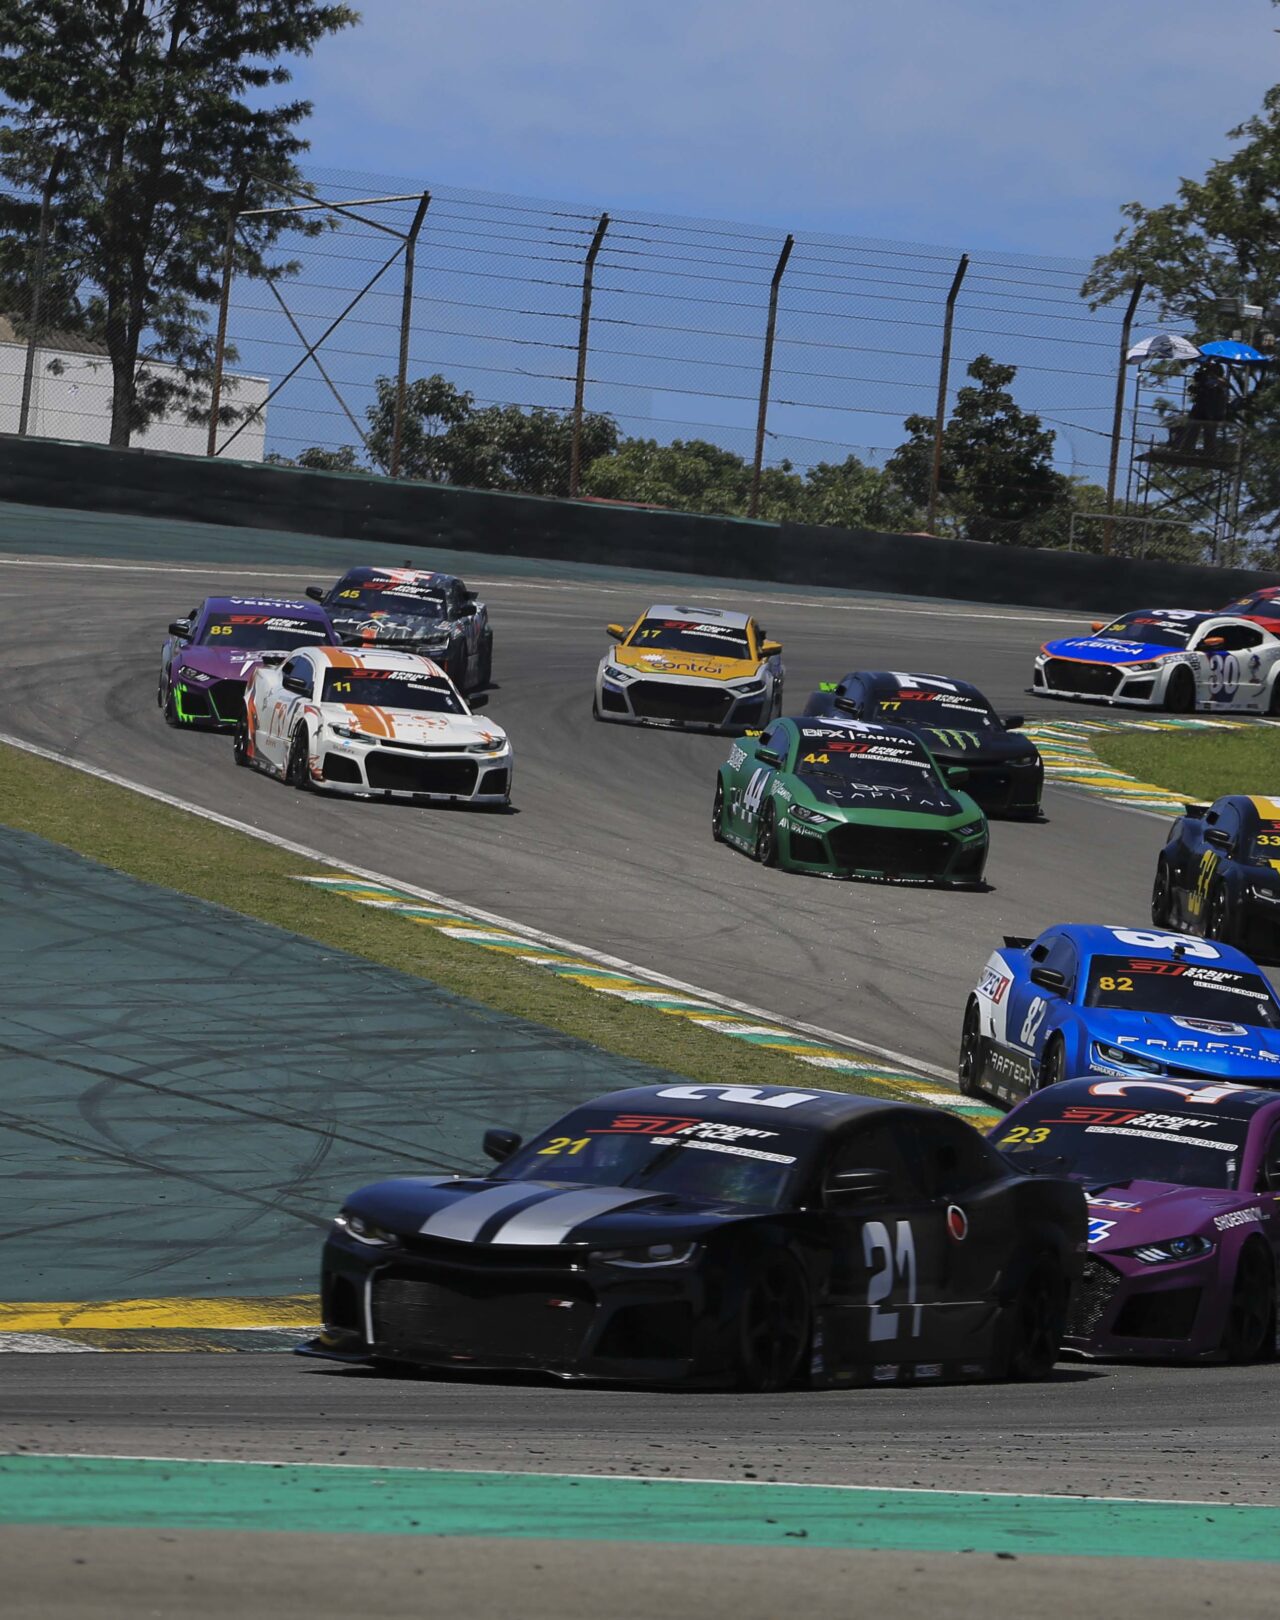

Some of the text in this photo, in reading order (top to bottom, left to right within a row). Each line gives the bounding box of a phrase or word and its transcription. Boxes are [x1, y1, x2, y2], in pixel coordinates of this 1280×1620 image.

[340, 589, 361, 599] 45
[210, 625, 233, 636] 85
[641, 629, 662, 639] 17
[1109, 624, 1127, 632] 30
[650, 660, 722, 674] control
[1208, 653, 1240, 695] 30
[333, 681, 352, 692] 11
[879, 701, 902, 711] 77
[856, 733, 916, 746] CAPITAL
[803, 753, 830, 764] 44
[743, 767, 771, 814] 44
[826, 789, 952, 808] CAPITAL
[1181, 970, 1224, 984] RACE
[1187, 966, 1243, 982] SPRINT
[1099, 976, 1135, 992] 82
[1020, 996, 1048, 1048] 82
[1124, 1116, 1183, 1131] RACE
[1137, 1112, 1219, 1129] SPRINT
[675, 1125, 738, 1142] RACE
[690, 1121, 780, 1139] SPRINT
[1001, 1126, 1051, 1144] 23
[536, 1137, 591, 1155] 21
[862, 1220, 922, 1342] 21
